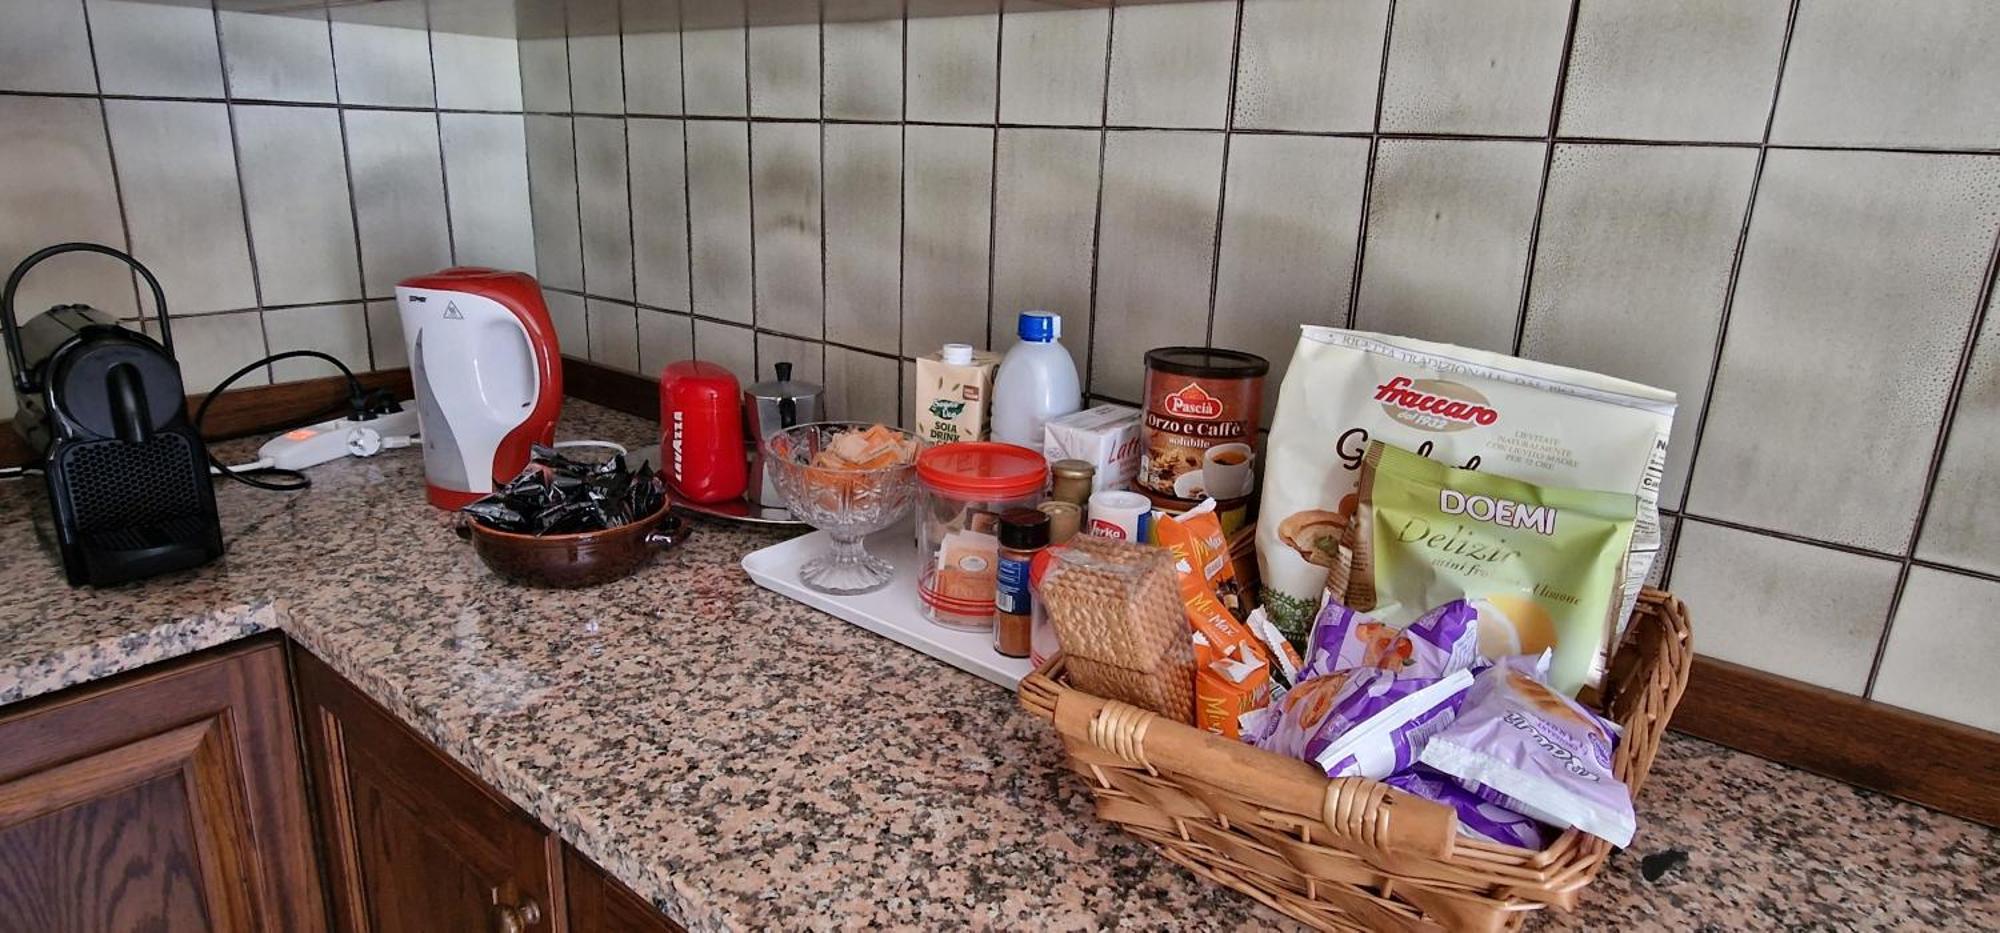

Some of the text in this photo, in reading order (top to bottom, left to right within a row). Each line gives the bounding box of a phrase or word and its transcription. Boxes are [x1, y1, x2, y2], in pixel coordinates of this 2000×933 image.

[1373, 376, 1499, 427] fraccaro
[934, 420, 957, 434] SOIA
[1148, 414, 1240, 437] Orzo e Caffè
[672, 411, 683, 482] LAVAZZA
[1108, 436, 1141, 465] Latt
[1440, 489, 1557, 536] DOEMI
